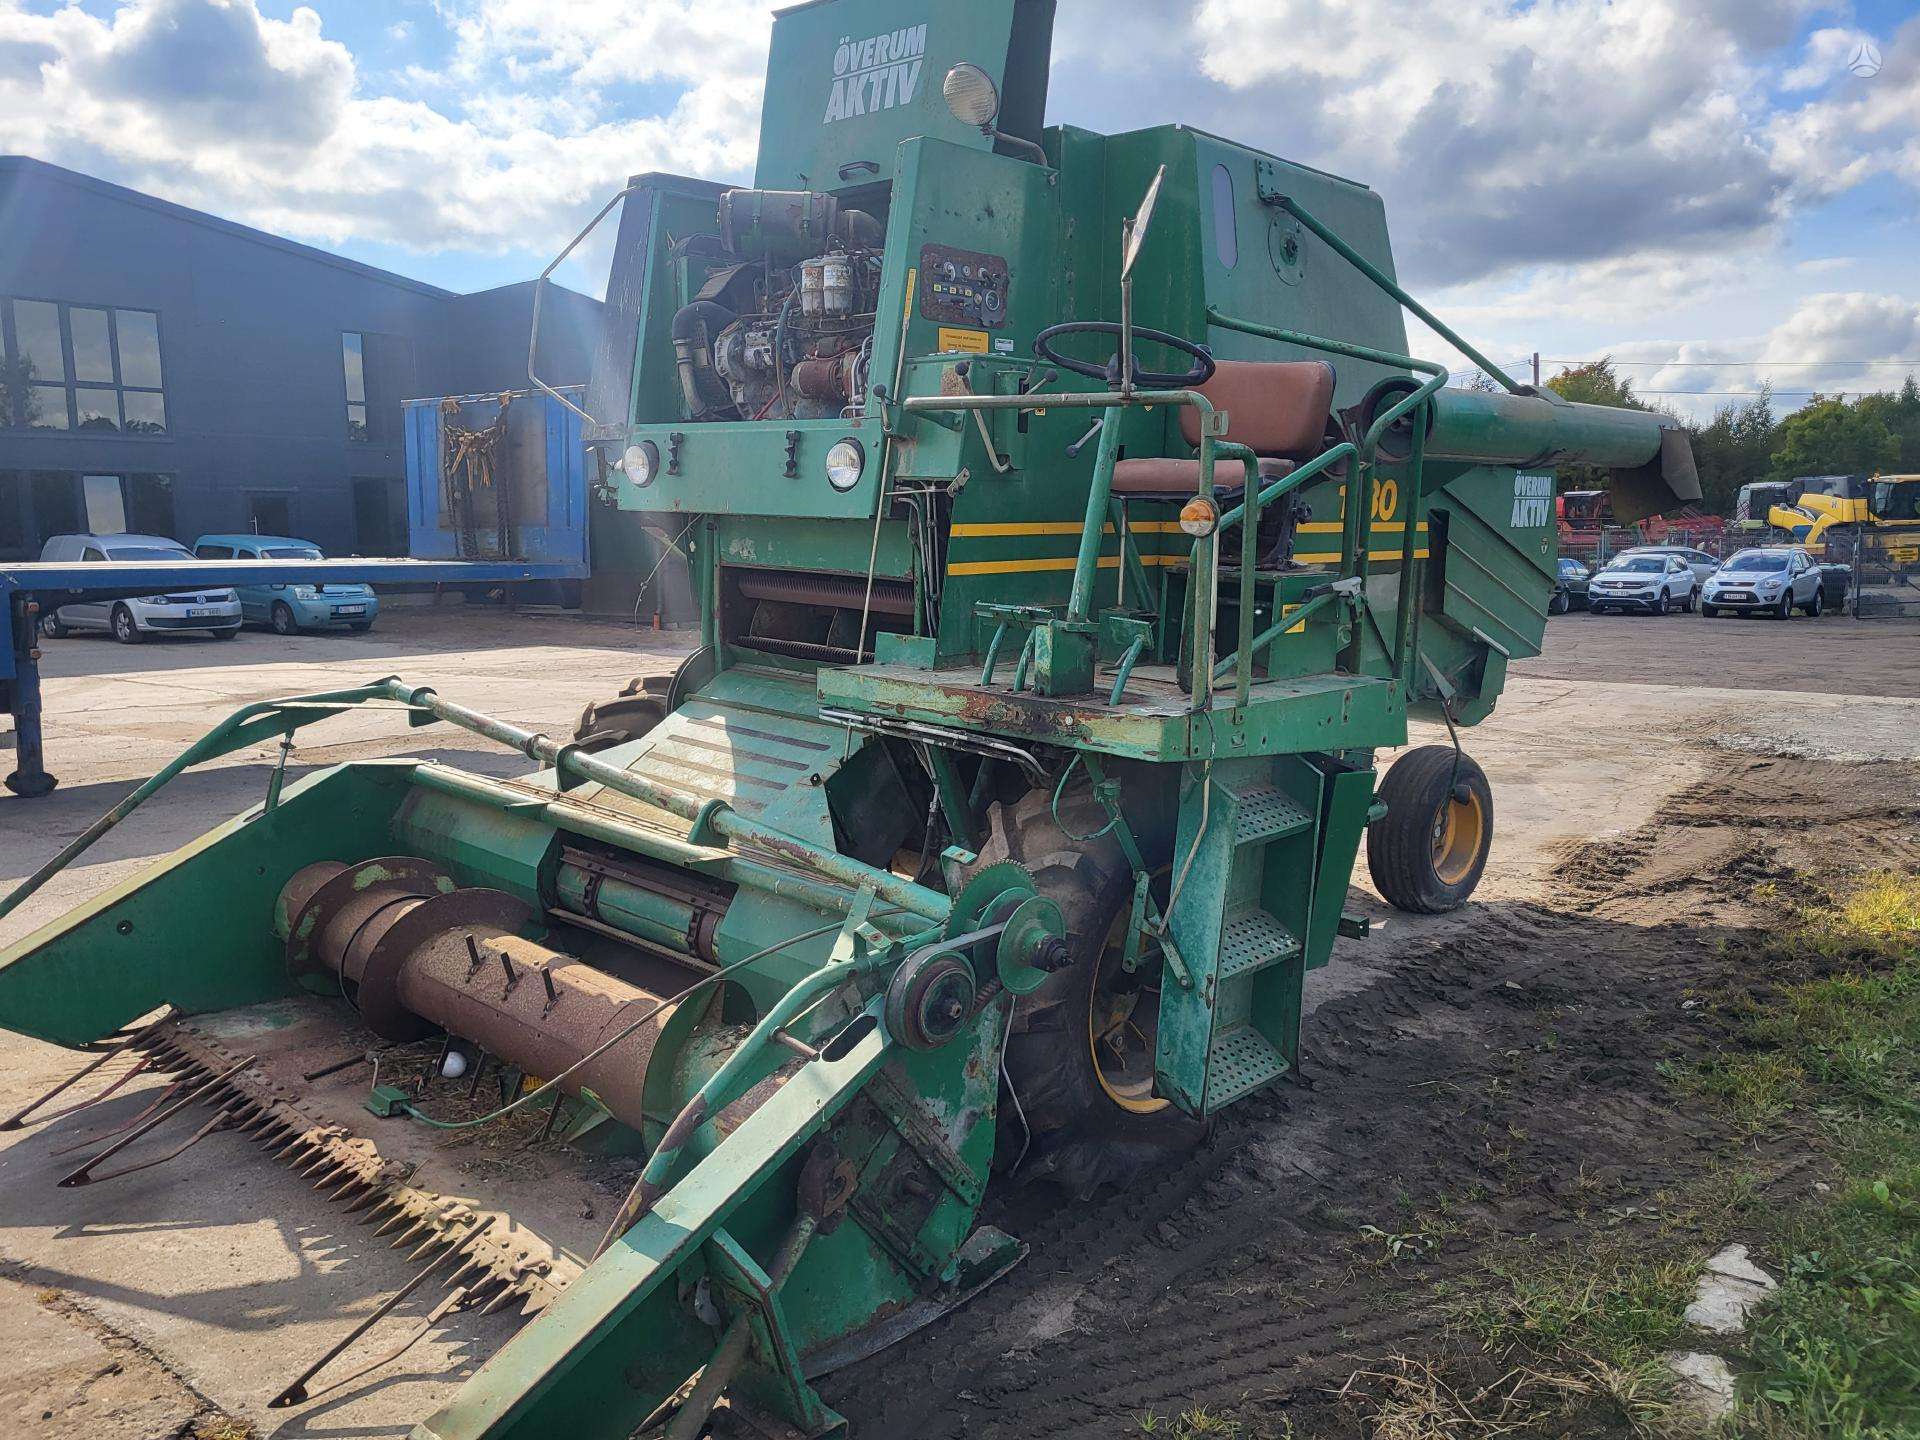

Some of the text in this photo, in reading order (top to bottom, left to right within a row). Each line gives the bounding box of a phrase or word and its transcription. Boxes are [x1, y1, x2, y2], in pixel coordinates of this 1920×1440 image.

[833, 23, 928, 76] ÖVERUM
[823, 60, 923, 124] AKTIV
[1514, 470, 1552, 496] ÖVERUM
[1511, 499, 1550, 528] AKTIV
